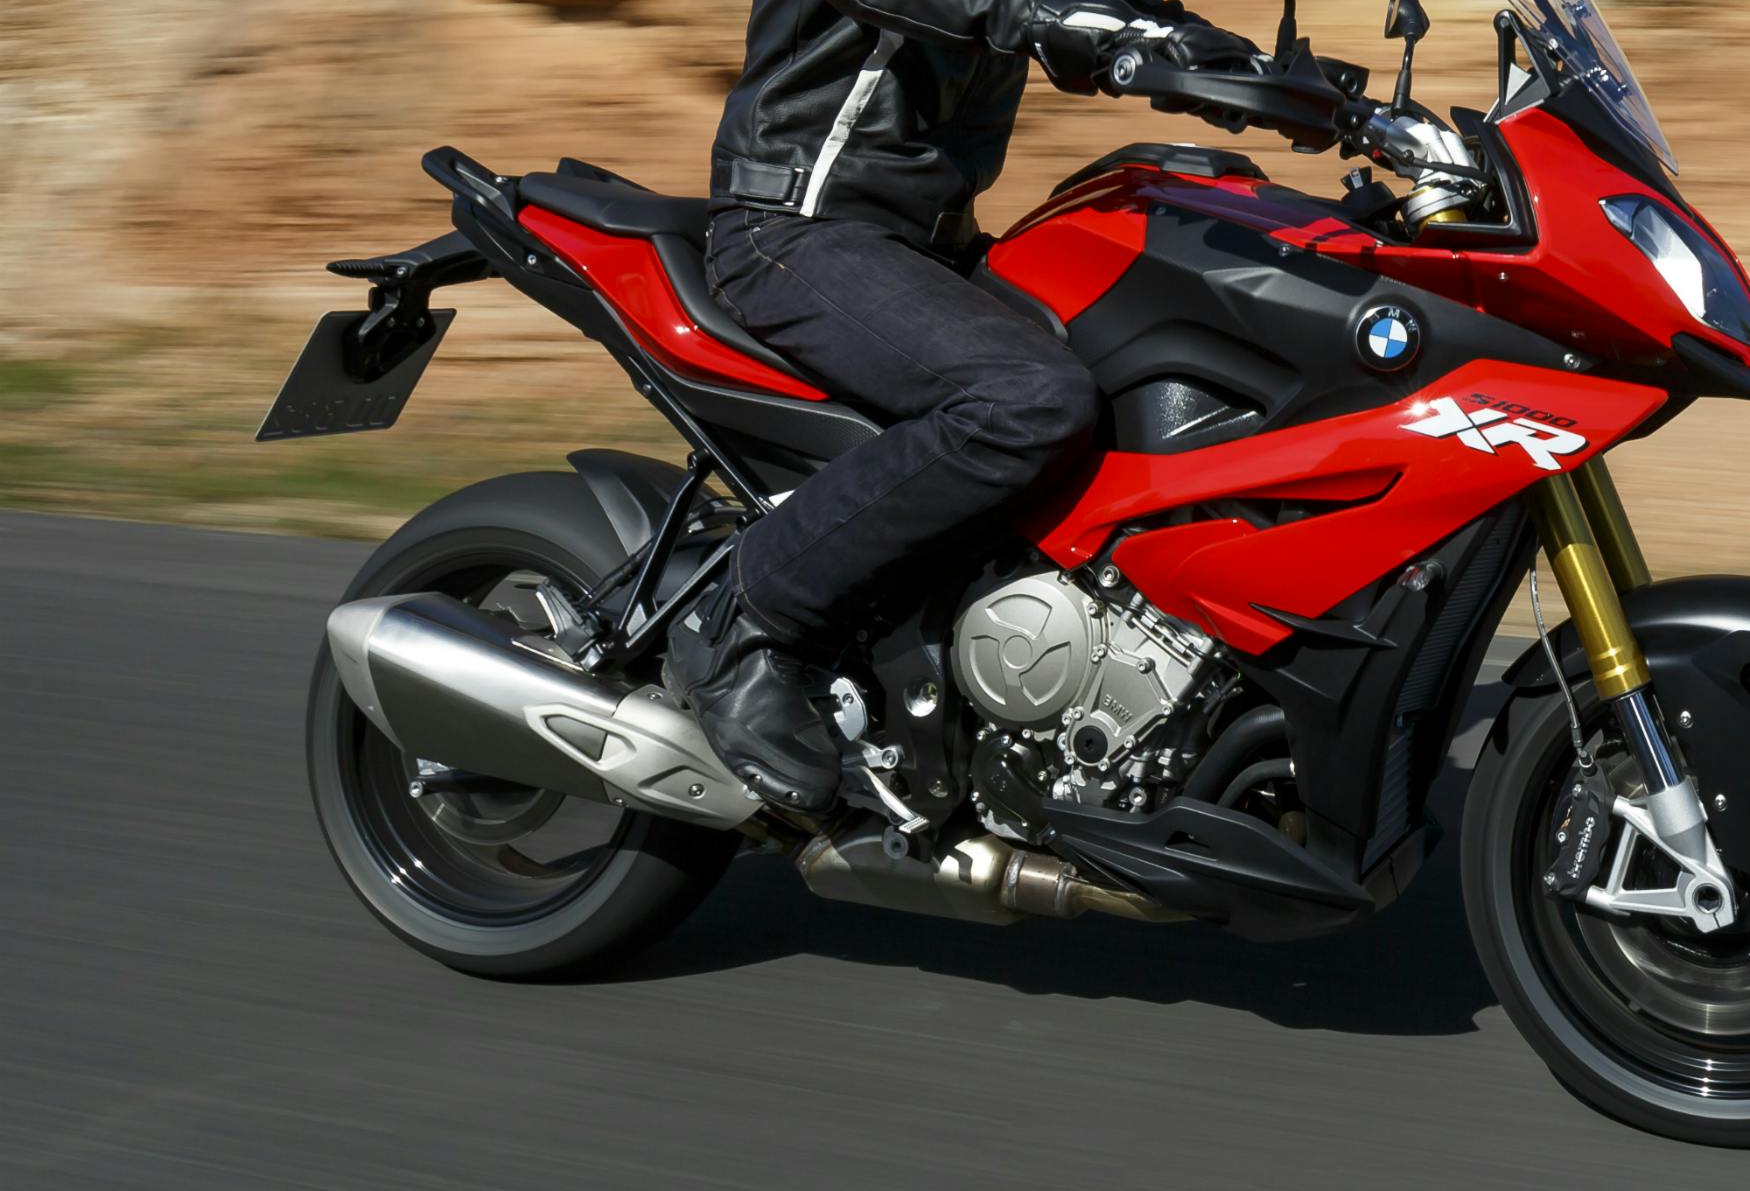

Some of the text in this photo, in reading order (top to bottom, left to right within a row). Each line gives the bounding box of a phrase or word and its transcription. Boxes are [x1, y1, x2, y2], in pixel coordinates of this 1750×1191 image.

[1397, 396, 1591, 472] XR
[1103, 693, 1134, 724] BMW
[1567, 816, 1597, 879] brembo
